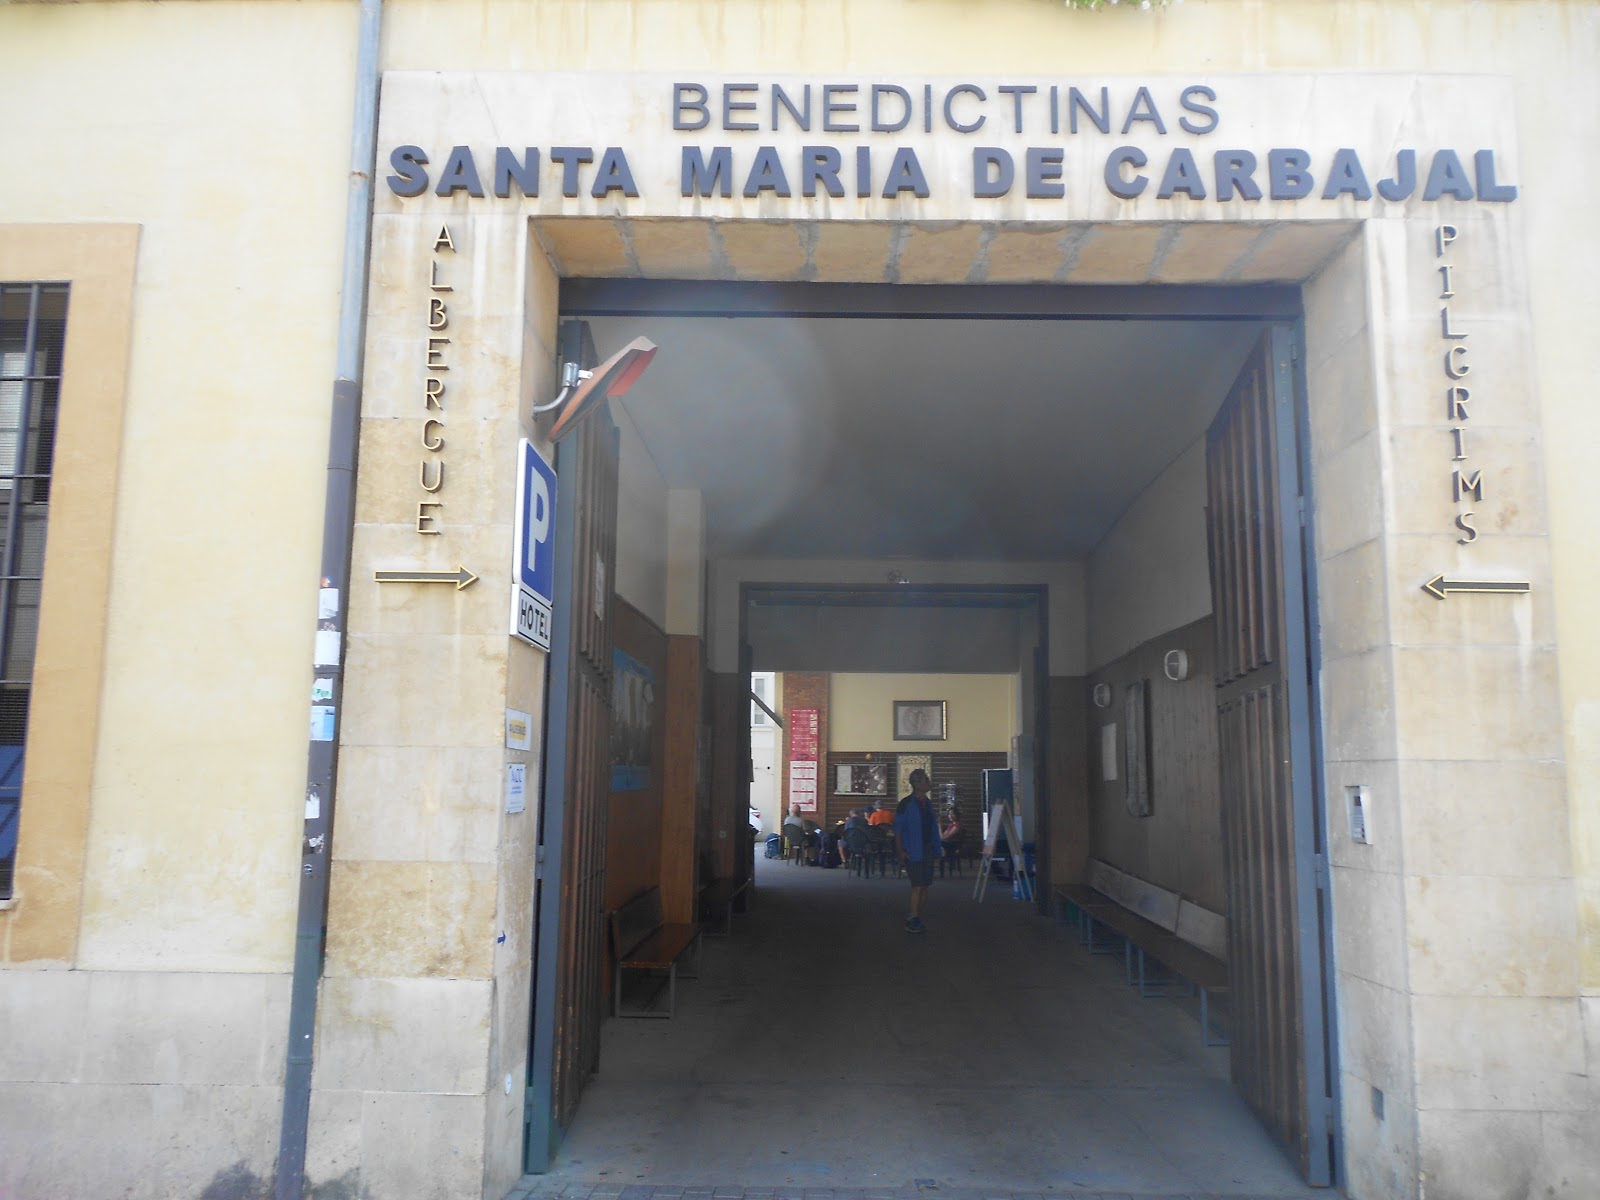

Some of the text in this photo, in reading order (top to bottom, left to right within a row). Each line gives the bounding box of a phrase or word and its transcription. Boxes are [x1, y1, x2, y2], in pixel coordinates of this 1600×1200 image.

[672, 82, 1220, 135] BENEDICTINAS
[386, 145, 1518, 203] SANTA MARIA DE CARBAJAL
[416, 223, 456, 535] ALBERGUE
[1435, 224, 1484, 545] PILGRIMS
[527, 466, 550, 572] P
[520, 599, 549, 640] HOTEL
